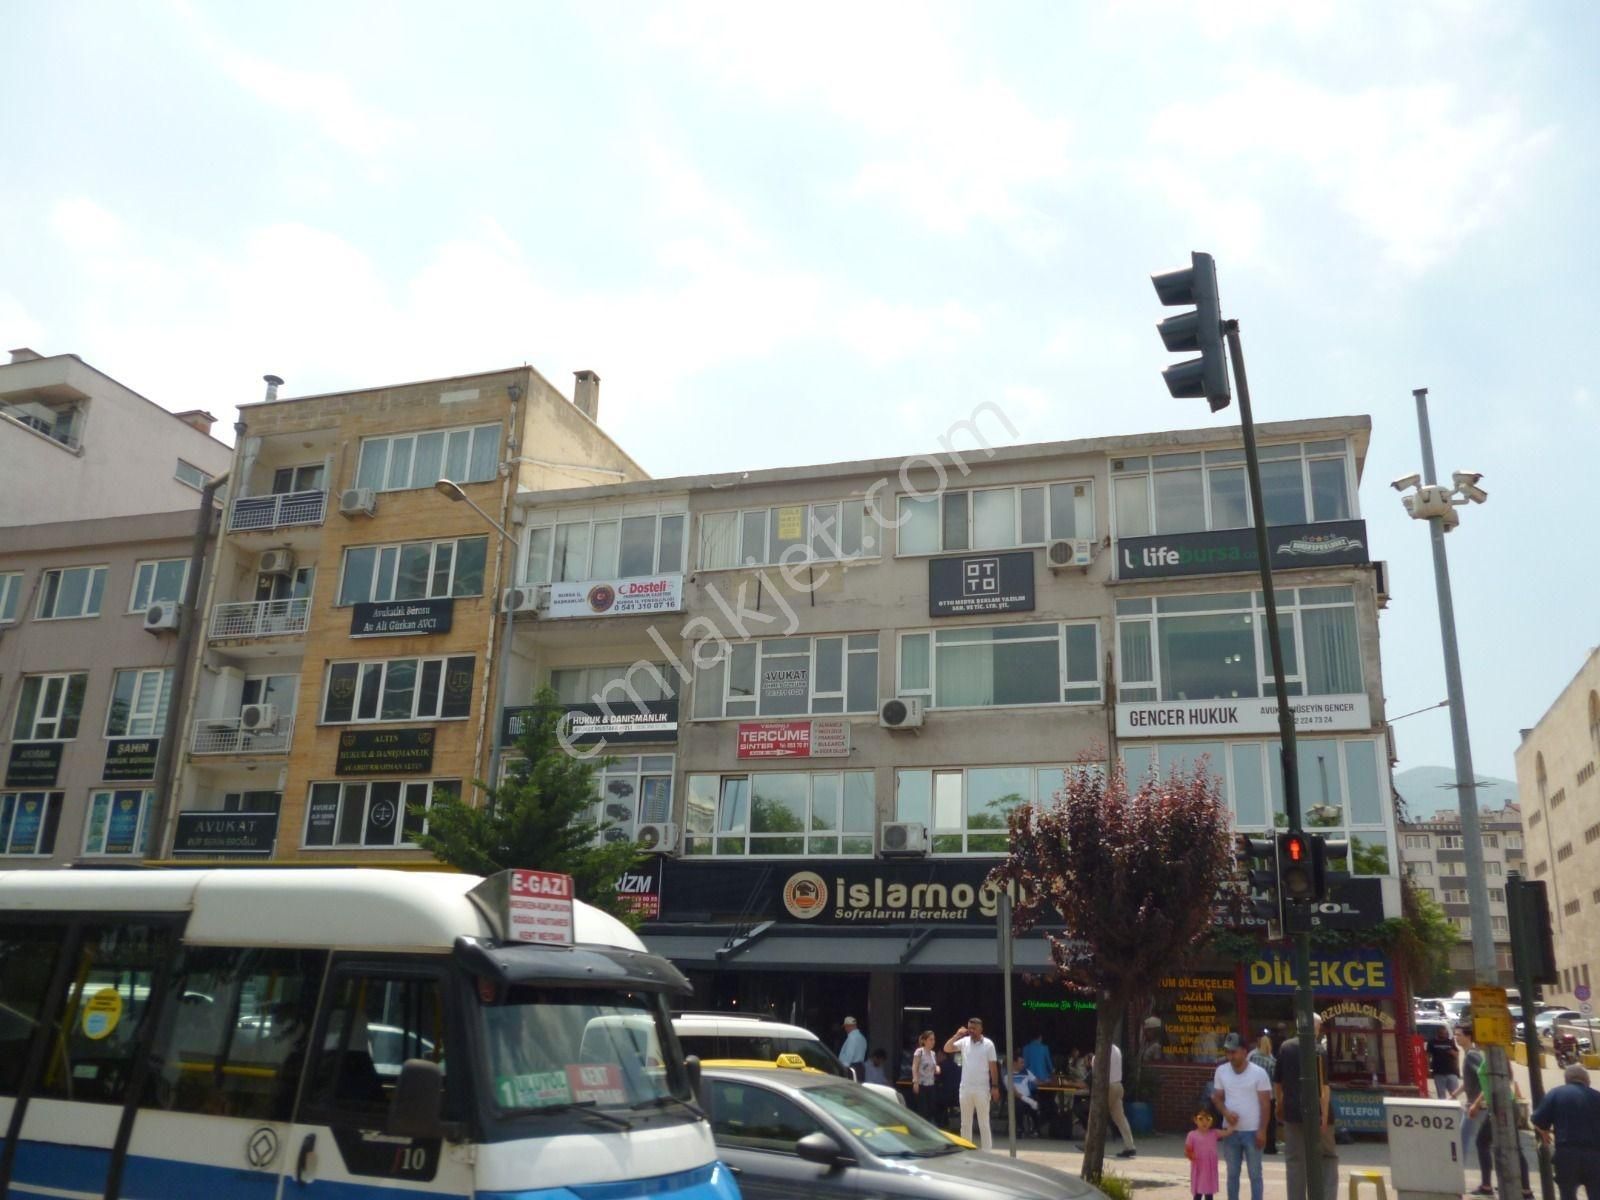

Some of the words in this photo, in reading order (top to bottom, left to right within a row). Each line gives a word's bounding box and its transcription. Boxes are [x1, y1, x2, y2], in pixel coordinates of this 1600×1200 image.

[629, 580, 667, 594] Dosteli
[1260, 706, 1280, 714] AVUK
[1324, 703, 1354, 712] GENCER
[573, 715, 601, 725] HUKUK
[610, 713, 668, 725] DANIŞMANLIK
[1130, 709, 1185, 727] GENCER
[1189, 707, 1238, 725] HUKUK
[740, 728, 809, 742] TERCÜME
[740, 742, 774, 750] SİNTER
[194, 821, 257, 833] AVUKAT
[512, 872, 568, 897] E-GAZİ
[834, 908, 906, 920] Sofraların
[909, 907, 968, 920] Bereketi
[1339, 1106, 1380, 1117] TELEFON
[1392, 1113, 1455, 1130] 02-002
